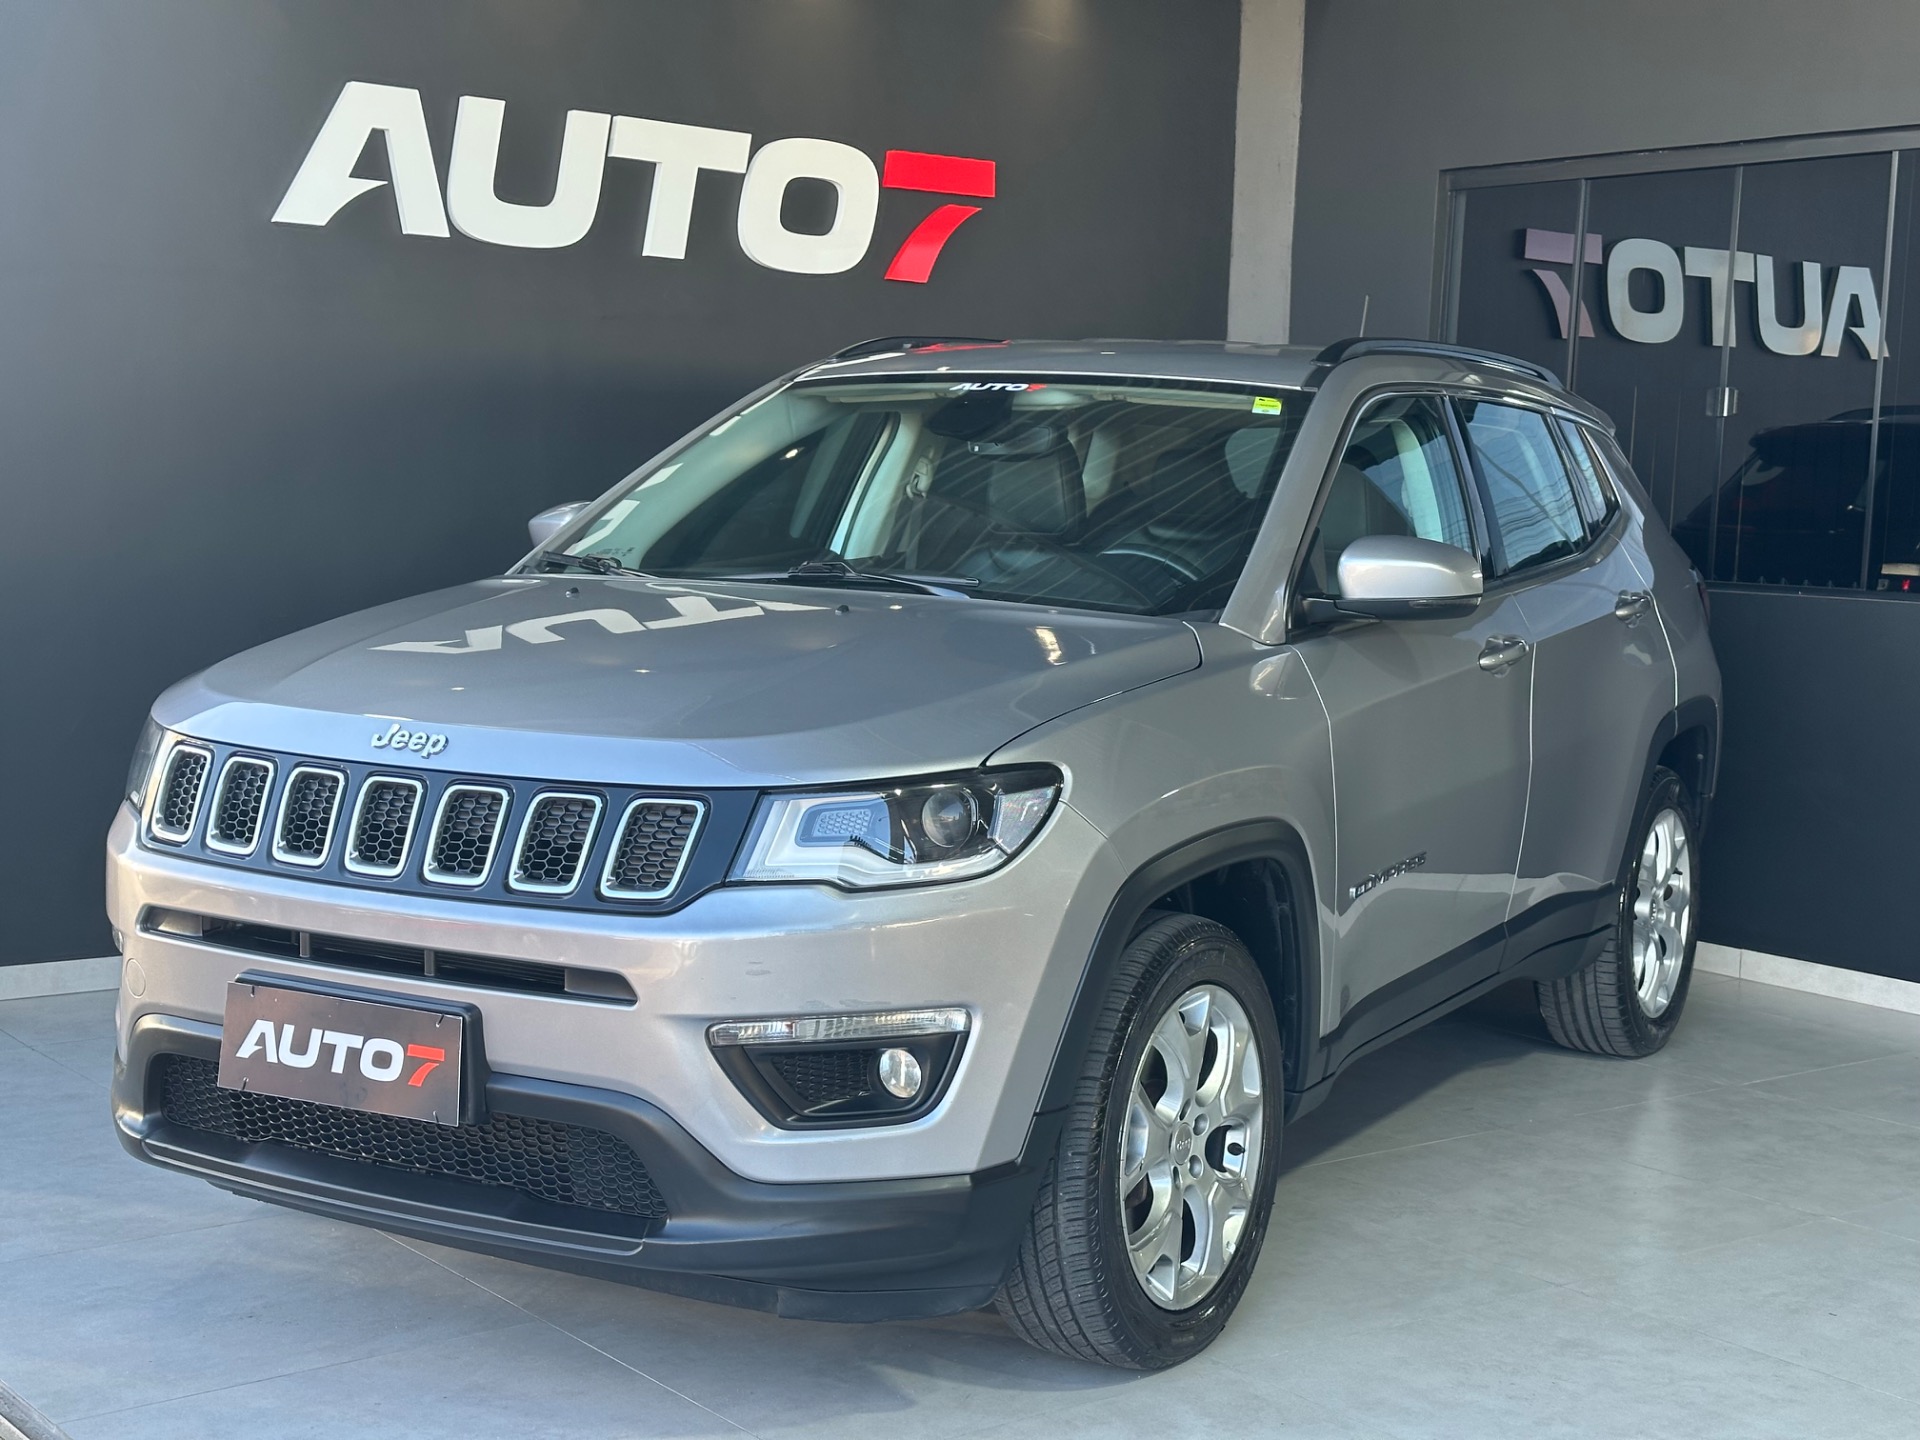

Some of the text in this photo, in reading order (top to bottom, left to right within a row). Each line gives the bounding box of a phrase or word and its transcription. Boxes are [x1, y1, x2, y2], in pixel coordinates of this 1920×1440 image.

[271, 80, 996, 284] AUTO7
[949, 382, 1048, 393] AUTO7
[370, 723, 450, 760] Jeep
[235, 1019, 445, 1088] AUTO7
